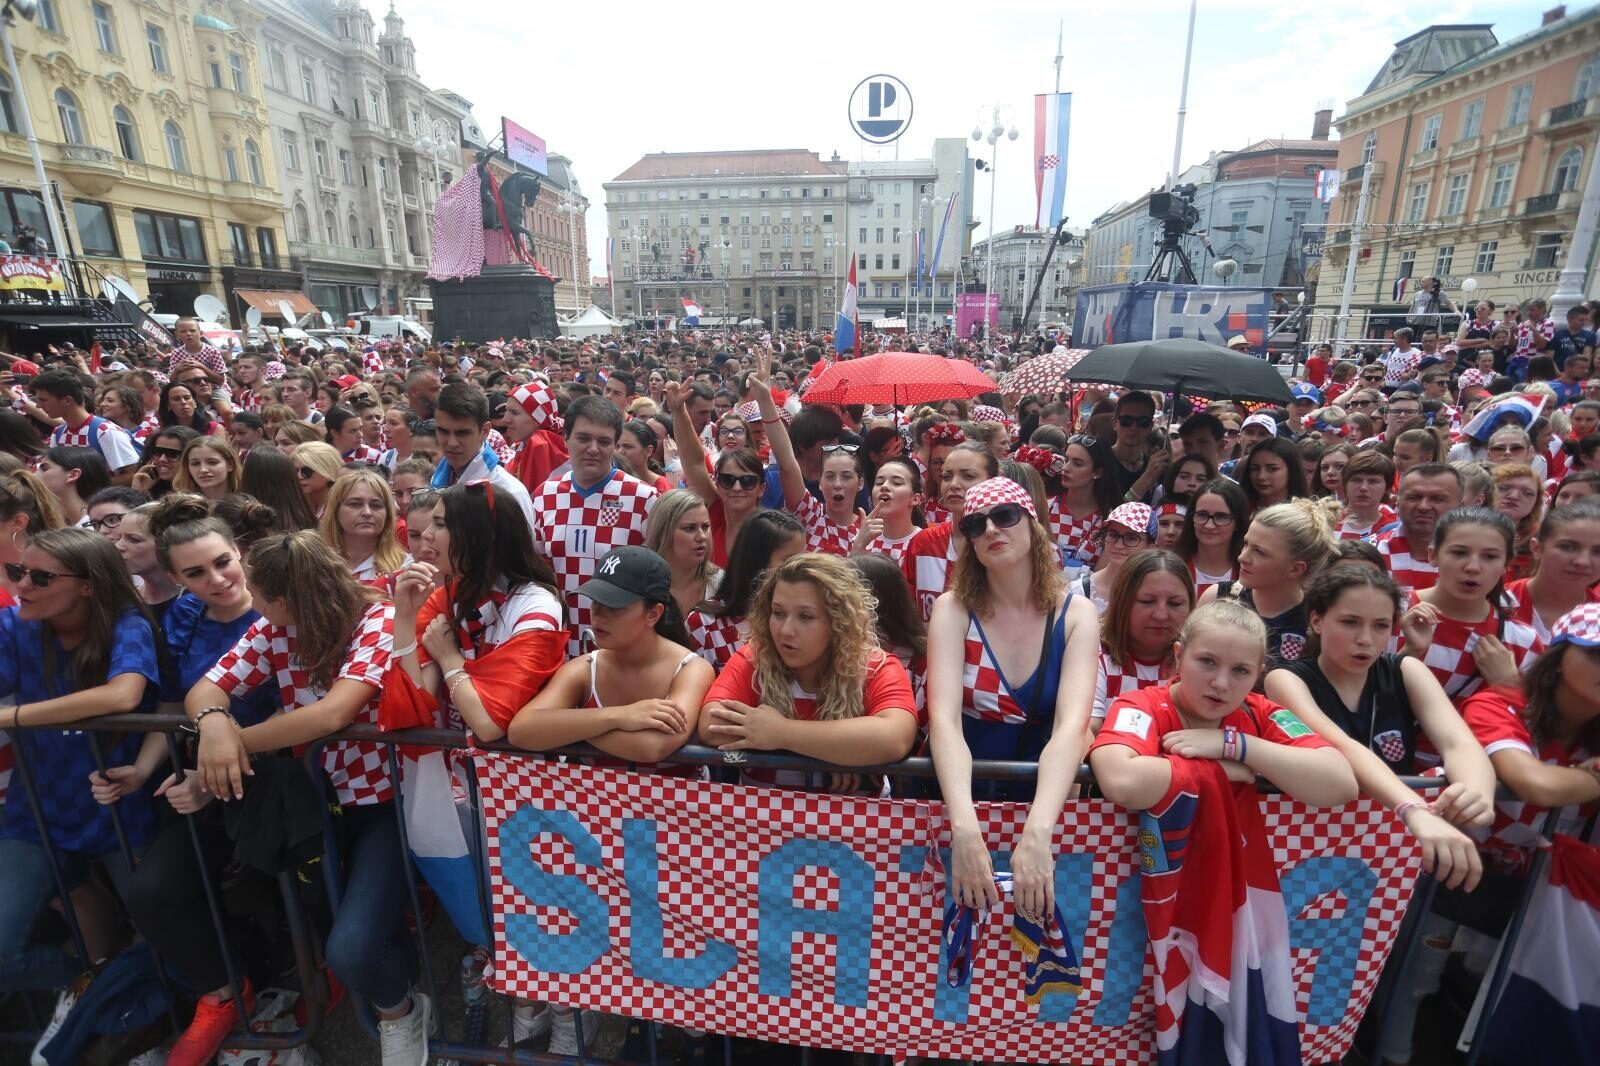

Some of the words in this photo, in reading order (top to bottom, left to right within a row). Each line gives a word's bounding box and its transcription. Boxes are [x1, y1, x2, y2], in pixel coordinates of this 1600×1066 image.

[1513, 270, 1562, 285] SINGER
[1152, 291, 1265, 347] HRT
[1519, 337, 1529, 348] 10
[574, 528, 588, 554] 11
[599, 554, 621, 575] NY
